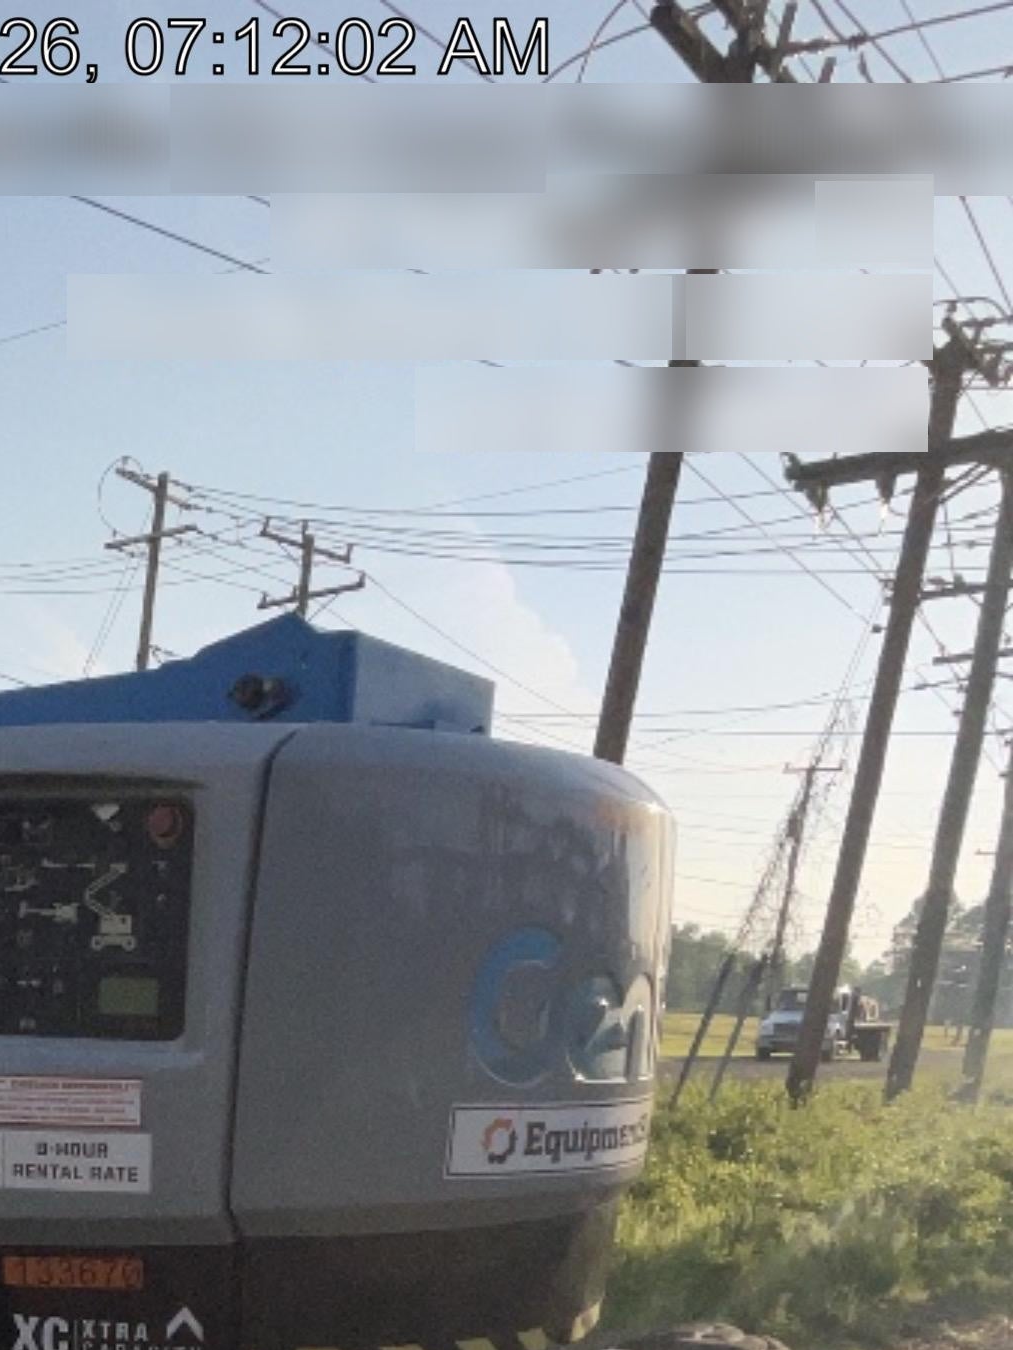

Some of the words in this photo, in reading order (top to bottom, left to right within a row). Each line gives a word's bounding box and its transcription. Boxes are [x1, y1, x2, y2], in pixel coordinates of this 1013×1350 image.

[13, 1162, 84, 1180] RENTAL
[89, 1166, 139, 1182] RATE
[82, 1319, 148, 1342] XTRA
